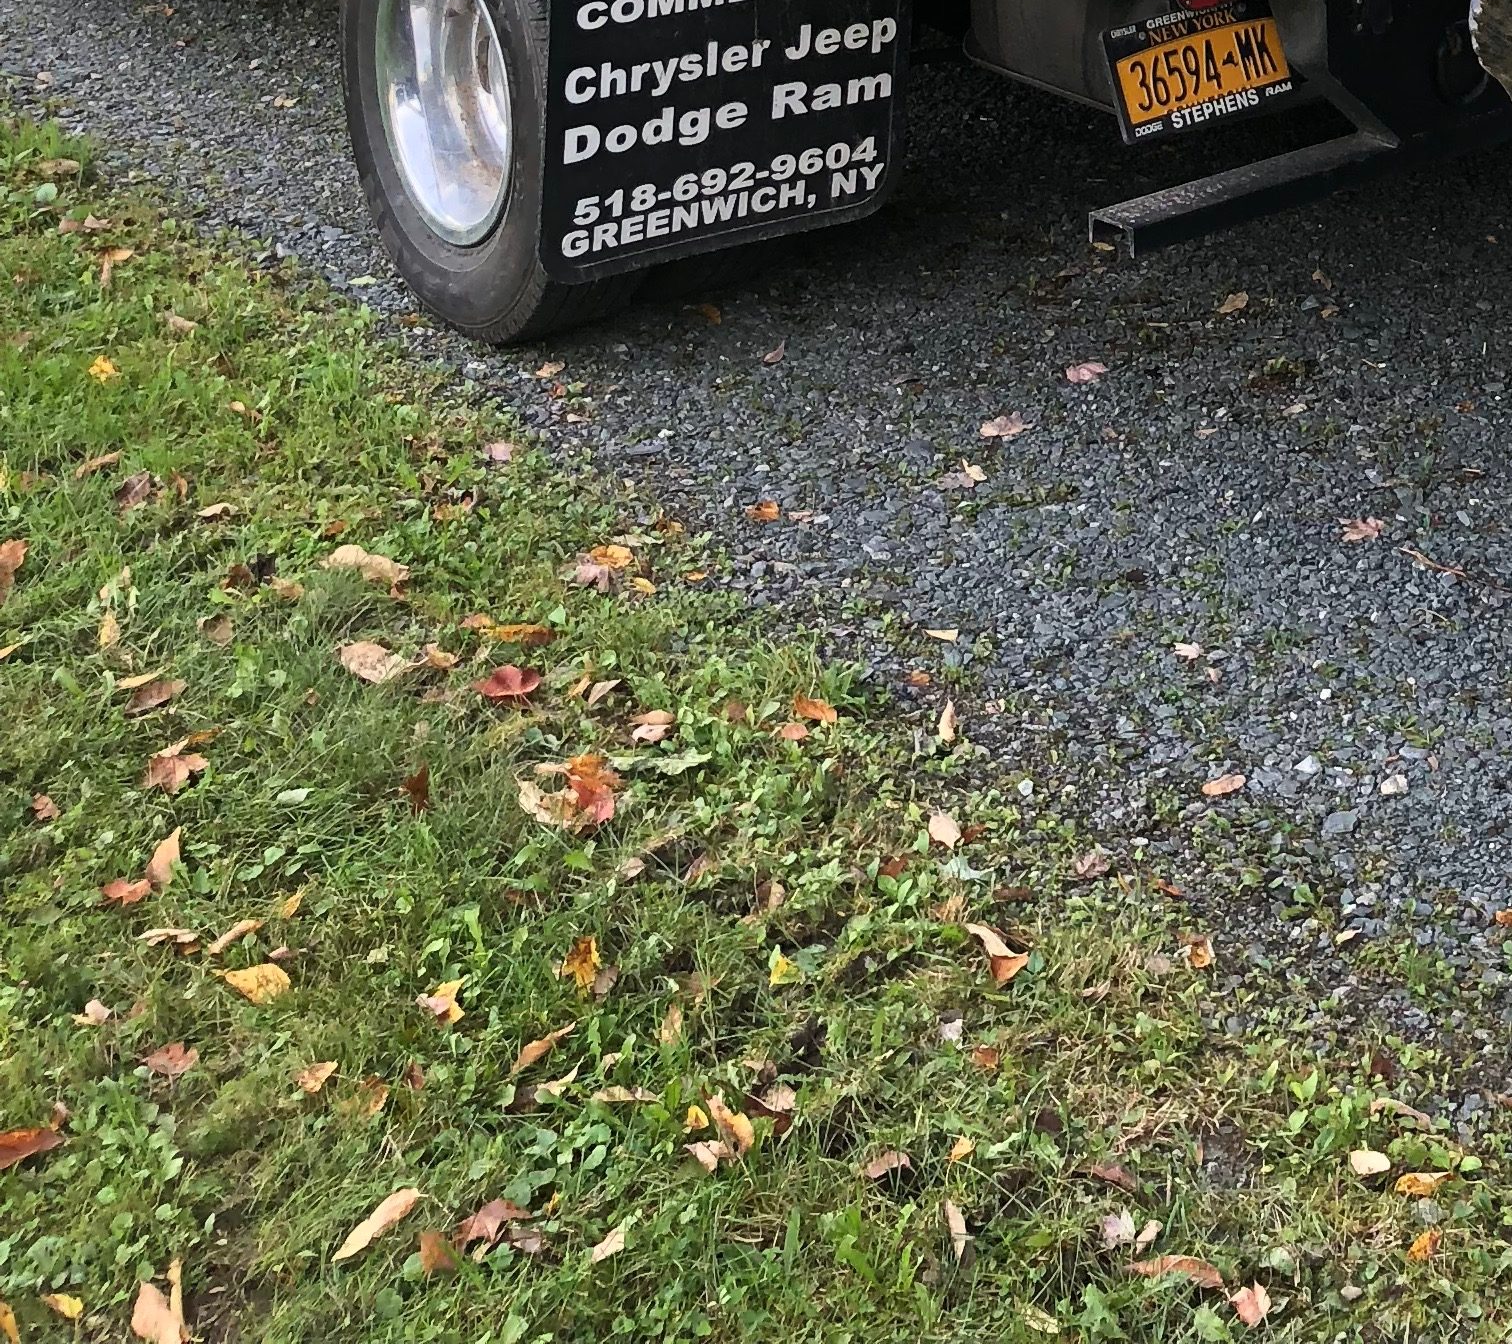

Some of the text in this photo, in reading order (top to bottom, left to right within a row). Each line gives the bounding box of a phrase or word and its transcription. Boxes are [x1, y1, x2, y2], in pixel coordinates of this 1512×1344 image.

[563, 16, 898, 105] Chrysler Jeep
[1129, 38, 1223, 113] 36594
[1233, 23, 1279, 82] MK
[1148, 7, 1238, 47] NEW YORK
[562, 71, 893, 166] Dodge Ram
[1135, 120, 1164, 138] DODGE
[1171, 88, 1260, 129] STEPHENS
[1265, 81, 1293, 97] RAM
[560, 162, 885, 259] GREENWICH, NY
[572, 135, 878, 227] 518-692-9604
